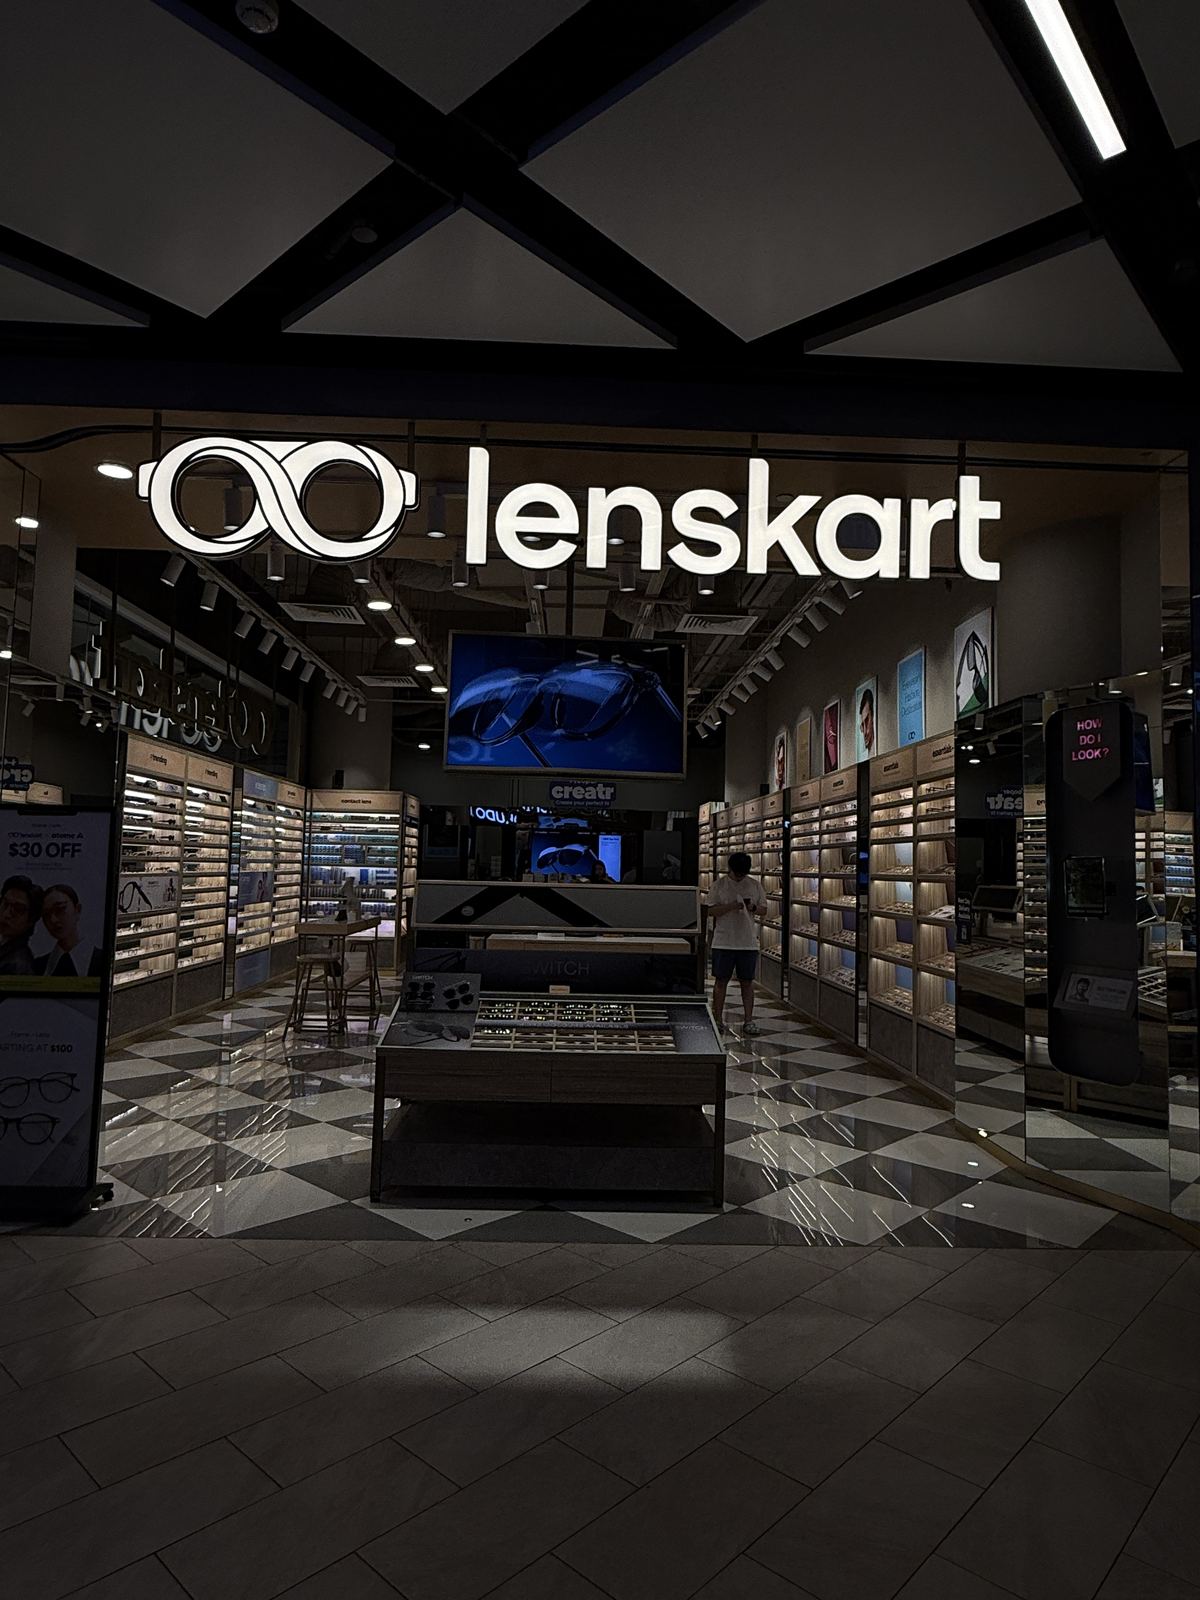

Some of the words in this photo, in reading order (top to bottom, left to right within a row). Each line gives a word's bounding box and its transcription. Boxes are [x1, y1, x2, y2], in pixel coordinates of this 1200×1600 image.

[465, 446, 1002, 582] lenskart
[1076, 718, 1104, 732] HOW
[1079, 734, 1096, 746] DO
[1071, 747, 1110, 762] LOOK?
[551, 783, 615, 800] creatr
[8, 841, 43, 858] $30
[44, 841, 82, 858] OFF
[35, 1043, 49, 1053] AT
[50, 1043, 74, 1053] $100
